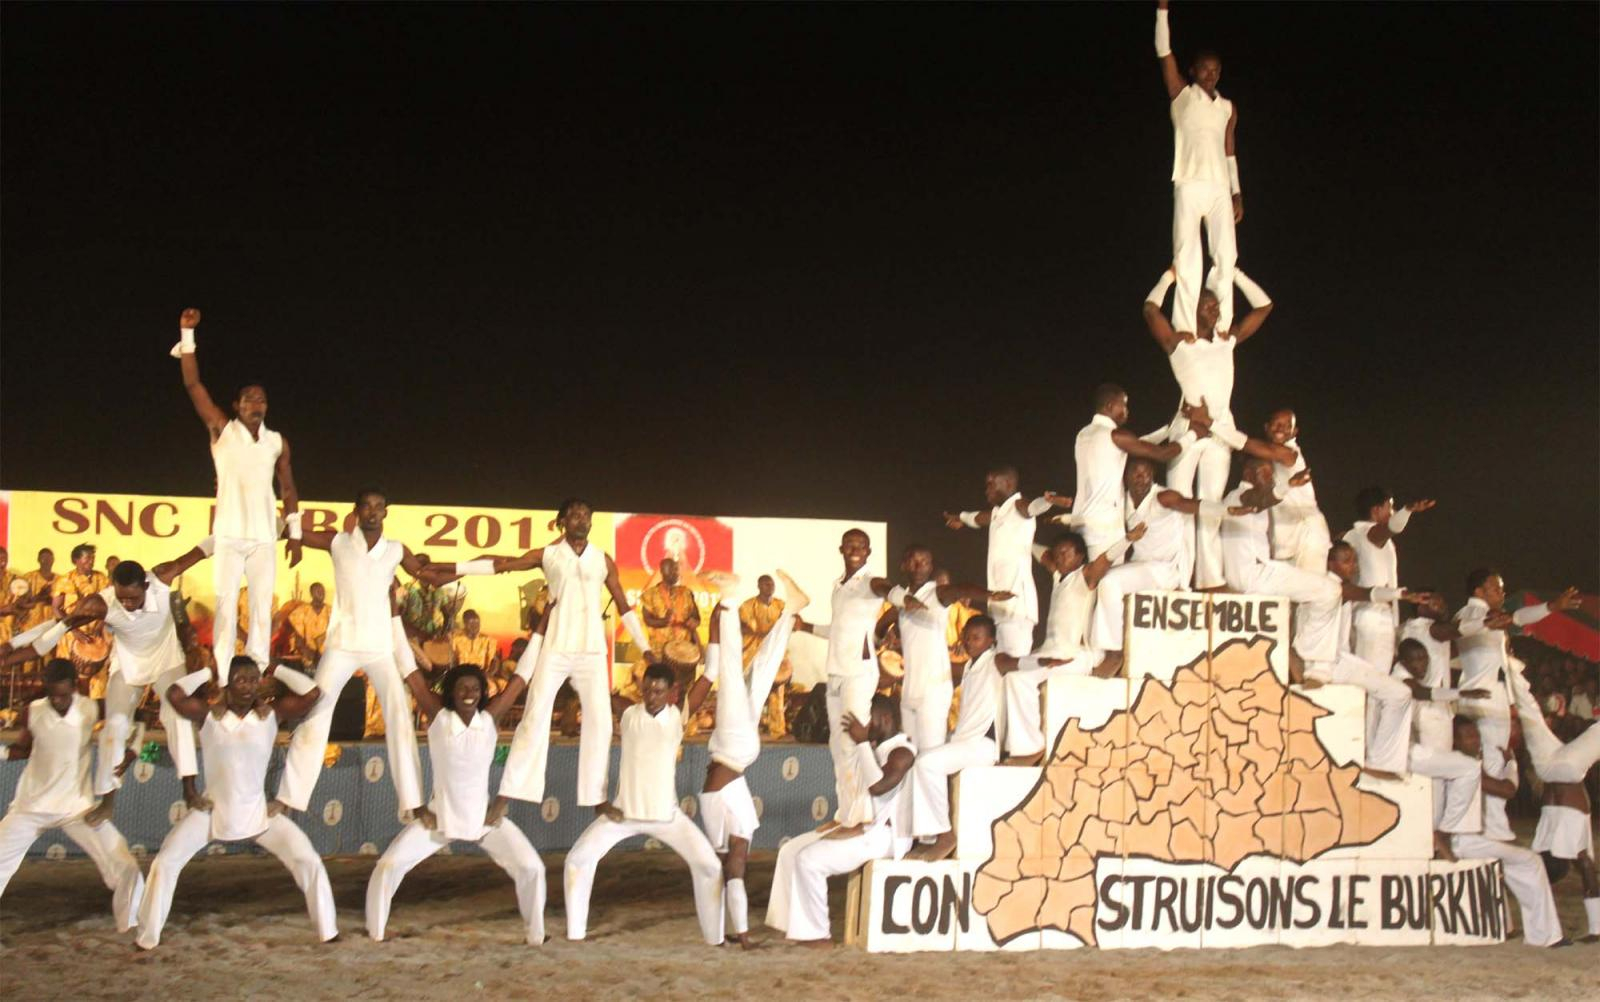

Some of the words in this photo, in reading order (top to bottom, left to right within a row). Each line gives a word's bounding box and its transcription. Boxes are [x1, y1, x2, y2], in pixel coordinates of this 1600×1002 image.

[52, 497, 181, 538] SNC
[1133, 593, 1279, 633] ENSEMBLE
[881, 872, 971, 935] CON
[1097, 873, 1322, 933] STRUISONS
[1327, 874, 1371, 929] LE
